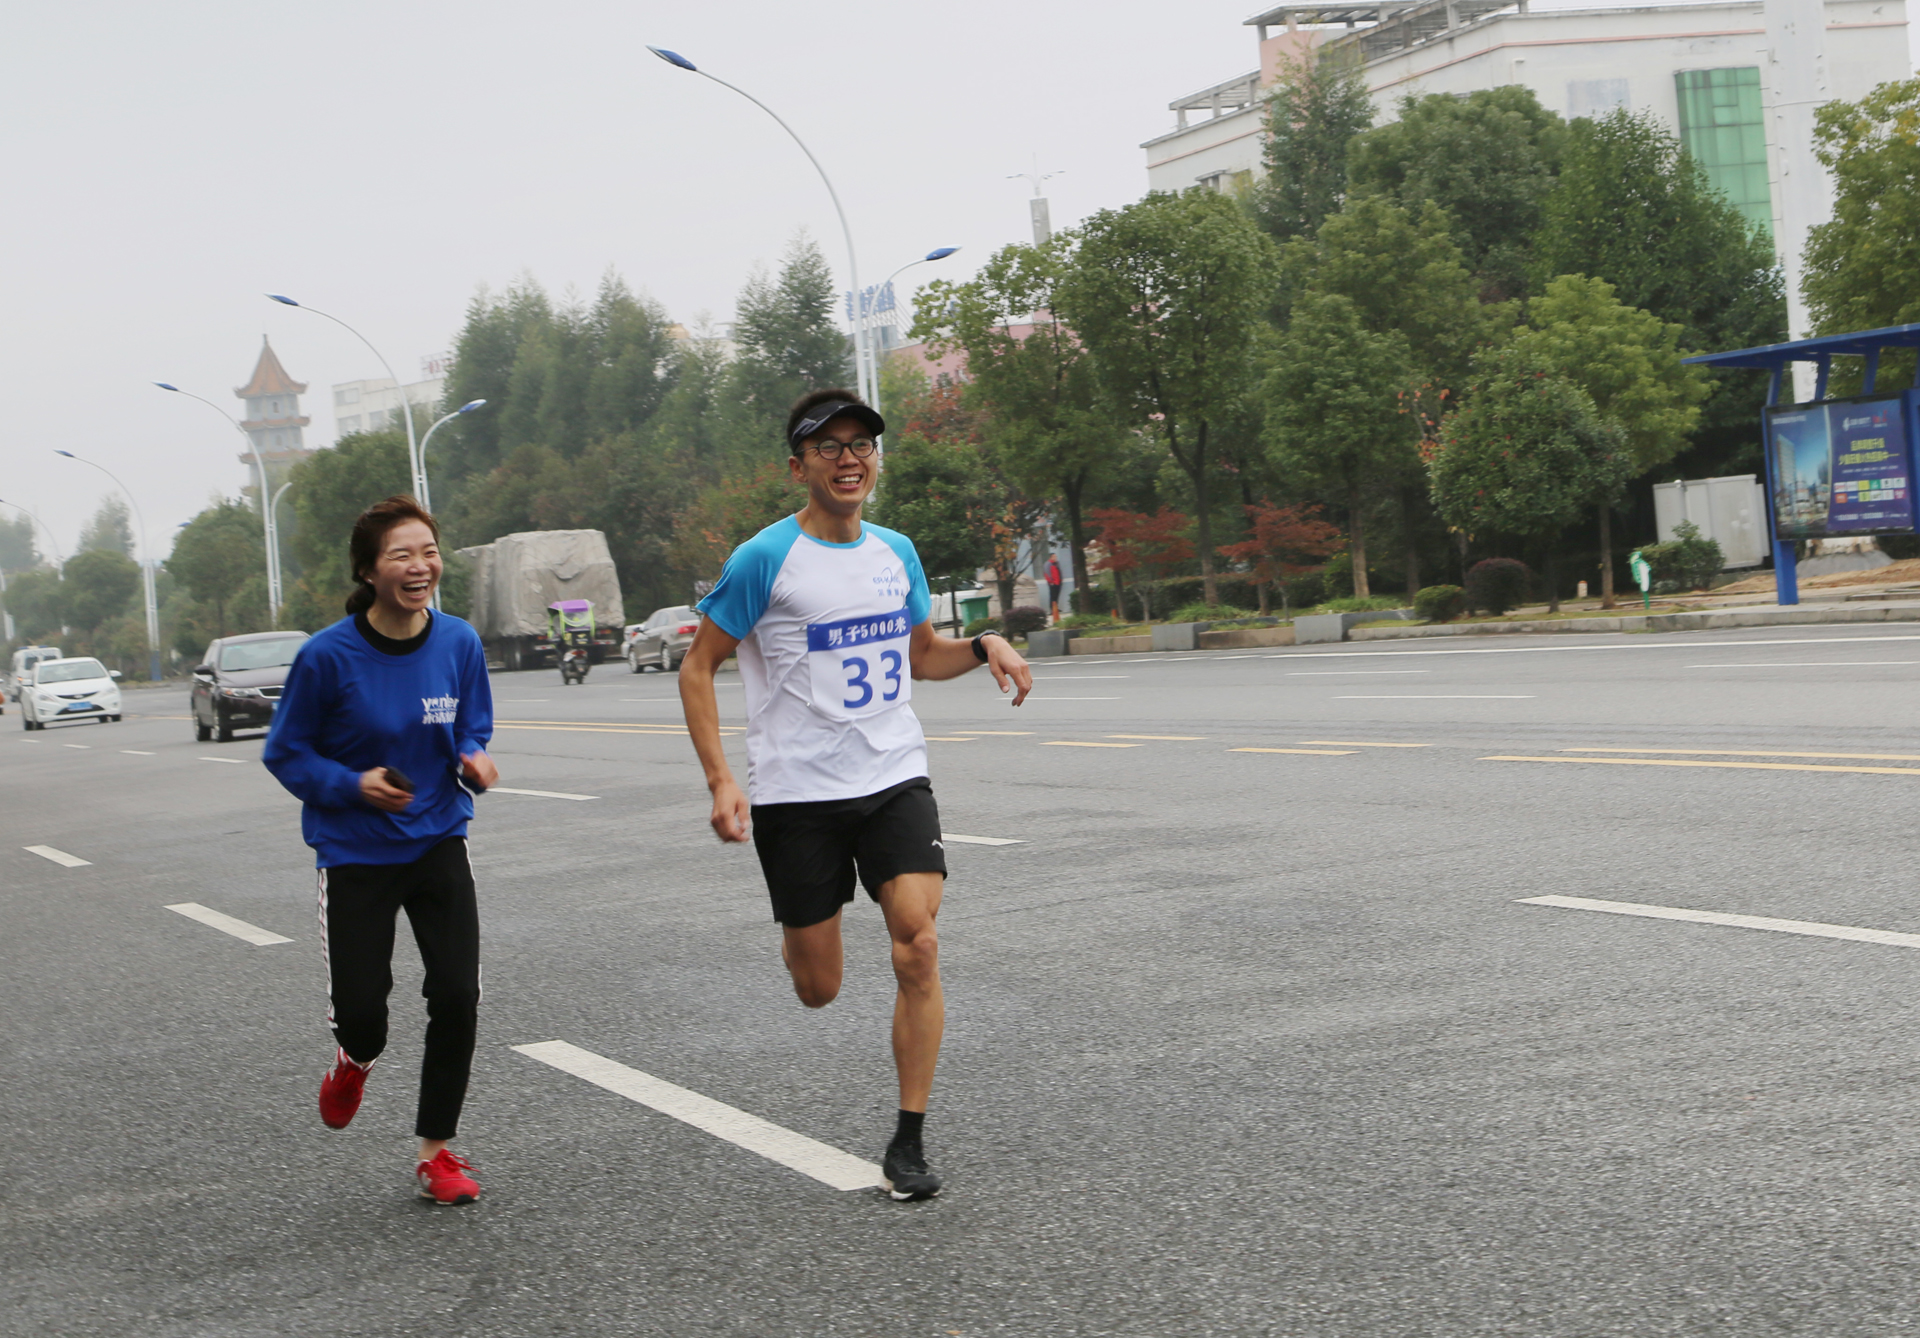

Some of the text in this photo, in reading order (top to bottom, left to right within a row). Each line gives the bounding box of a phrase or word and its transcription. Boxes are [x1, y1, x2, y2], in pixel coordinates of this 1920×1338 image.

[828, 616, 906, 647] 男子5000米
[842, 649, 902, 709] 33
